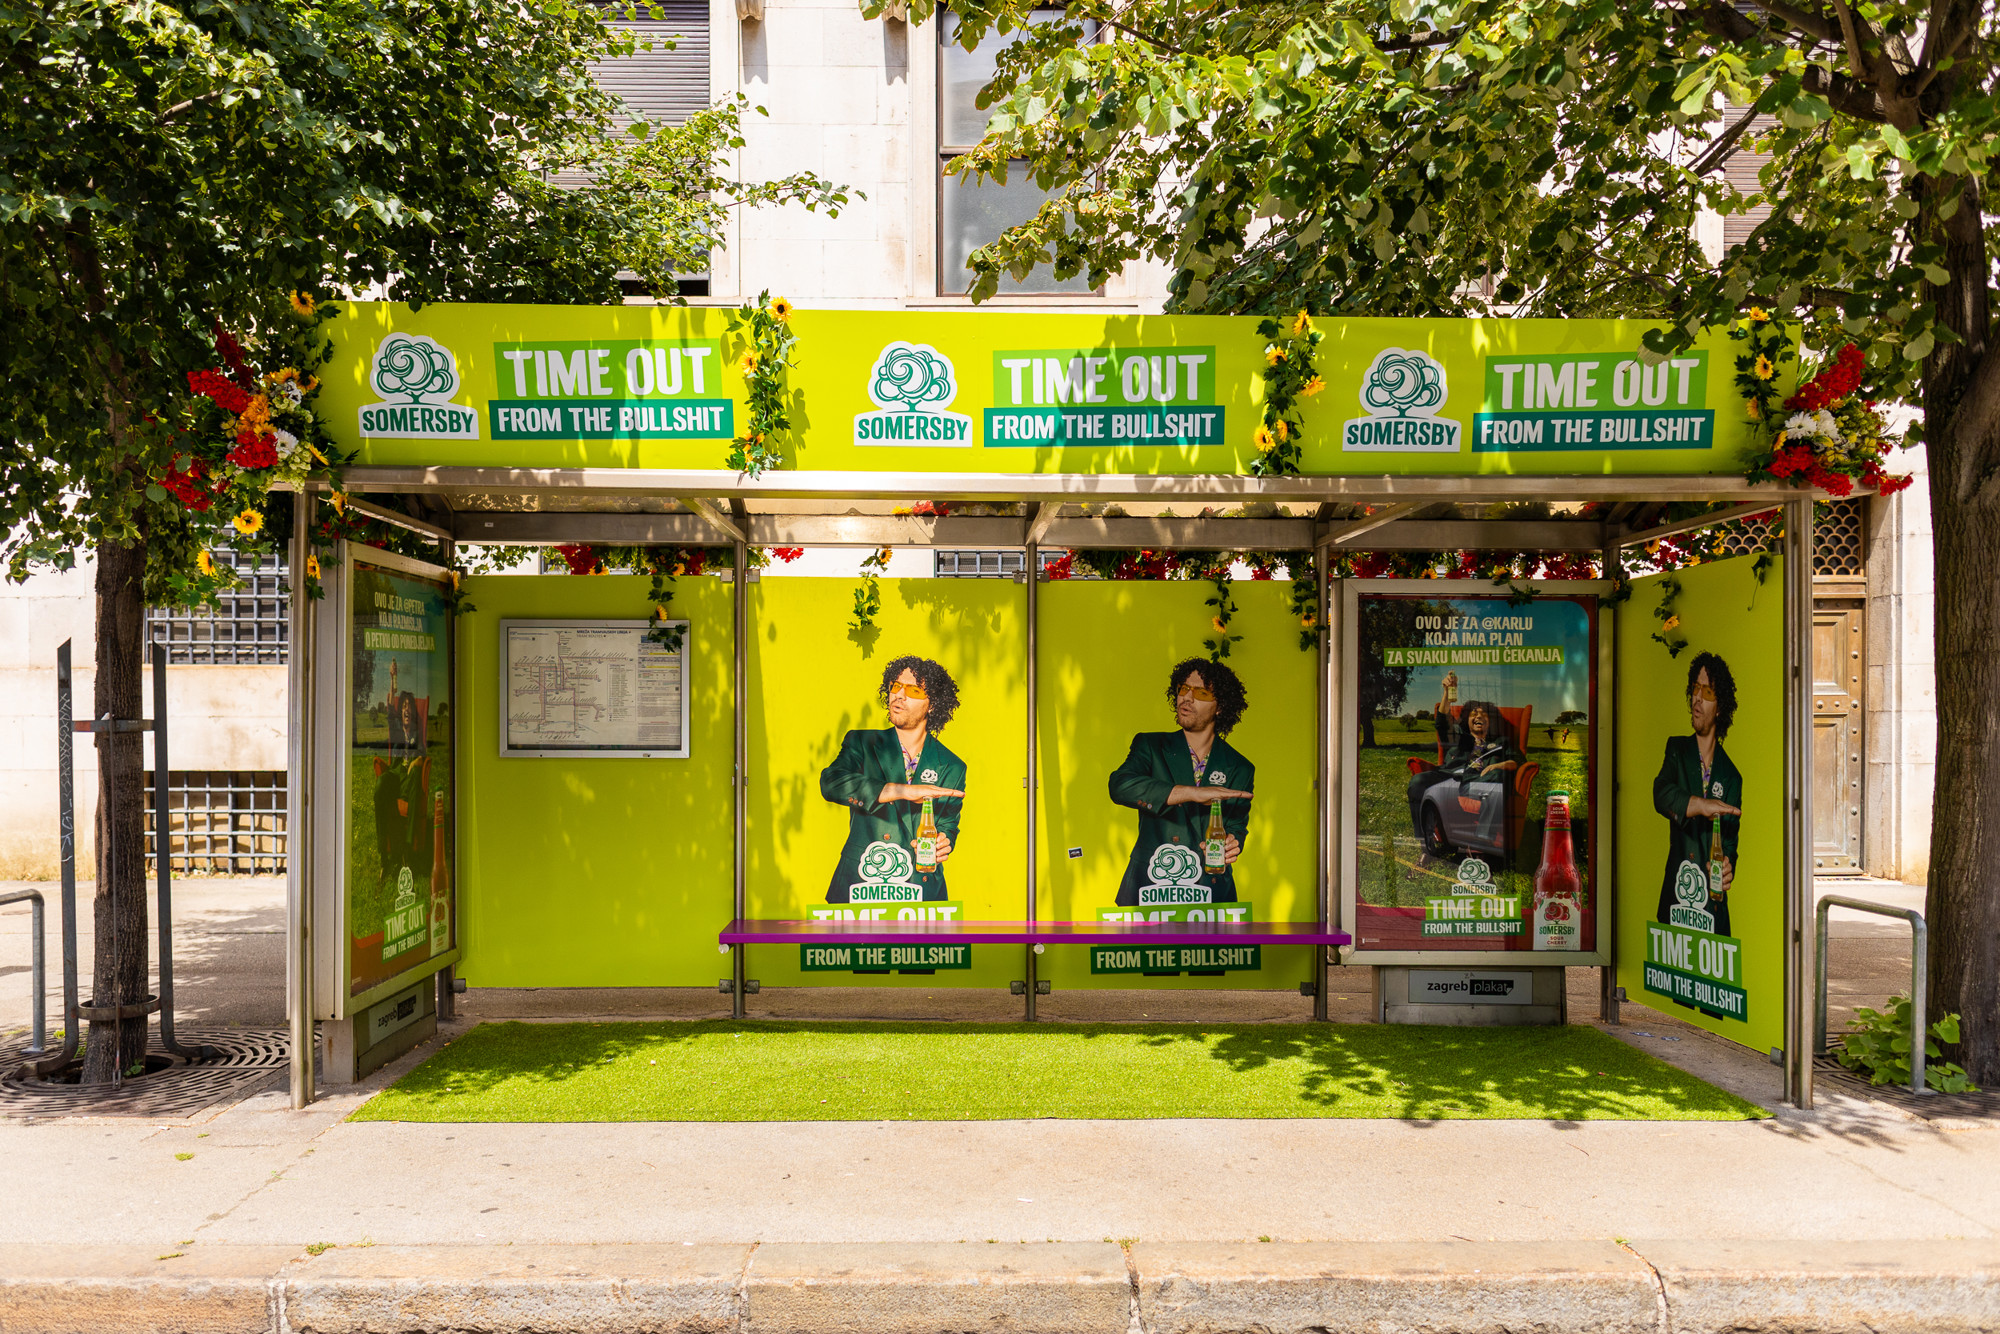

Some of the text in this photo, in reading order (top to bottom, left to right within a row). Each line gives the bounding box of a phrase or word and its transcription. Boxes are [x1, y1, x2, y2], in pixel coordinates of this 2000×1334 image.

[503, 347, 711, 397] TIME OUT
[1001, 354, 1207, 405] TIME OUT
[1494, 358, 1700, 410] TIME OUT
[362, 407, 473, 433] SOMERSBY
[498, 406, 724, 432] FROM THE BULLSHIT
[858, 415, 968, 441] SOMERSBY
[992, 413, 1216, 440] FROM THE BULLSHIT
[1347, 421, 1457, 446] SOMERSBY
[1481, 417, 1705, 444] FROM THE BULLSHIT
[375, 592, 386, 608] OVO
[388, 595, 395, 610] JE
[396, 596, 403, 611] ZA
[1415, 615, 1533, 631] OVO JE ZA @KARLU
[365, 632, 371, 648] O
[371, 632, 390, 648] PETKU
[391, 633, 400, 649] OD
[1425, 631, 1523, 646] KOJA IMA PLAN
[1387, 646, 1561, 665] ZA SVAKU MINUTU ČEKANJA
[852, 885, 920, 900] SOMERSBY
[1141, 887, 1209, 903] SOMERSBY
[1453, 884, 1495, 894] SOMERSBY
[1429, 897, 1518, 919] TIME OUT
[385, 911, 407, 942] TIME
[408, 904, 424, 931] OUT
[1424, 921, 1522, 934] FROM THE BULLSHIT
[1539, 925, 1575, 935] SOMERSBY
[1671, 907, 1714, 932] SOMERSBY
[383, 943, 398, 961] FROM
[398, 940, 407, 953] THE
[806, 946, 965, 966] FROM THE BULLSHIT
[1096, 948, 1255, 969] FROM THE BULLSHIT
[1650, 927, 1738, 982] TIME OUT
[1427, 980, 1508, 995] zagreb plakat
[1646, 967, 1743, 1014] FROM THE BULLSHIT
